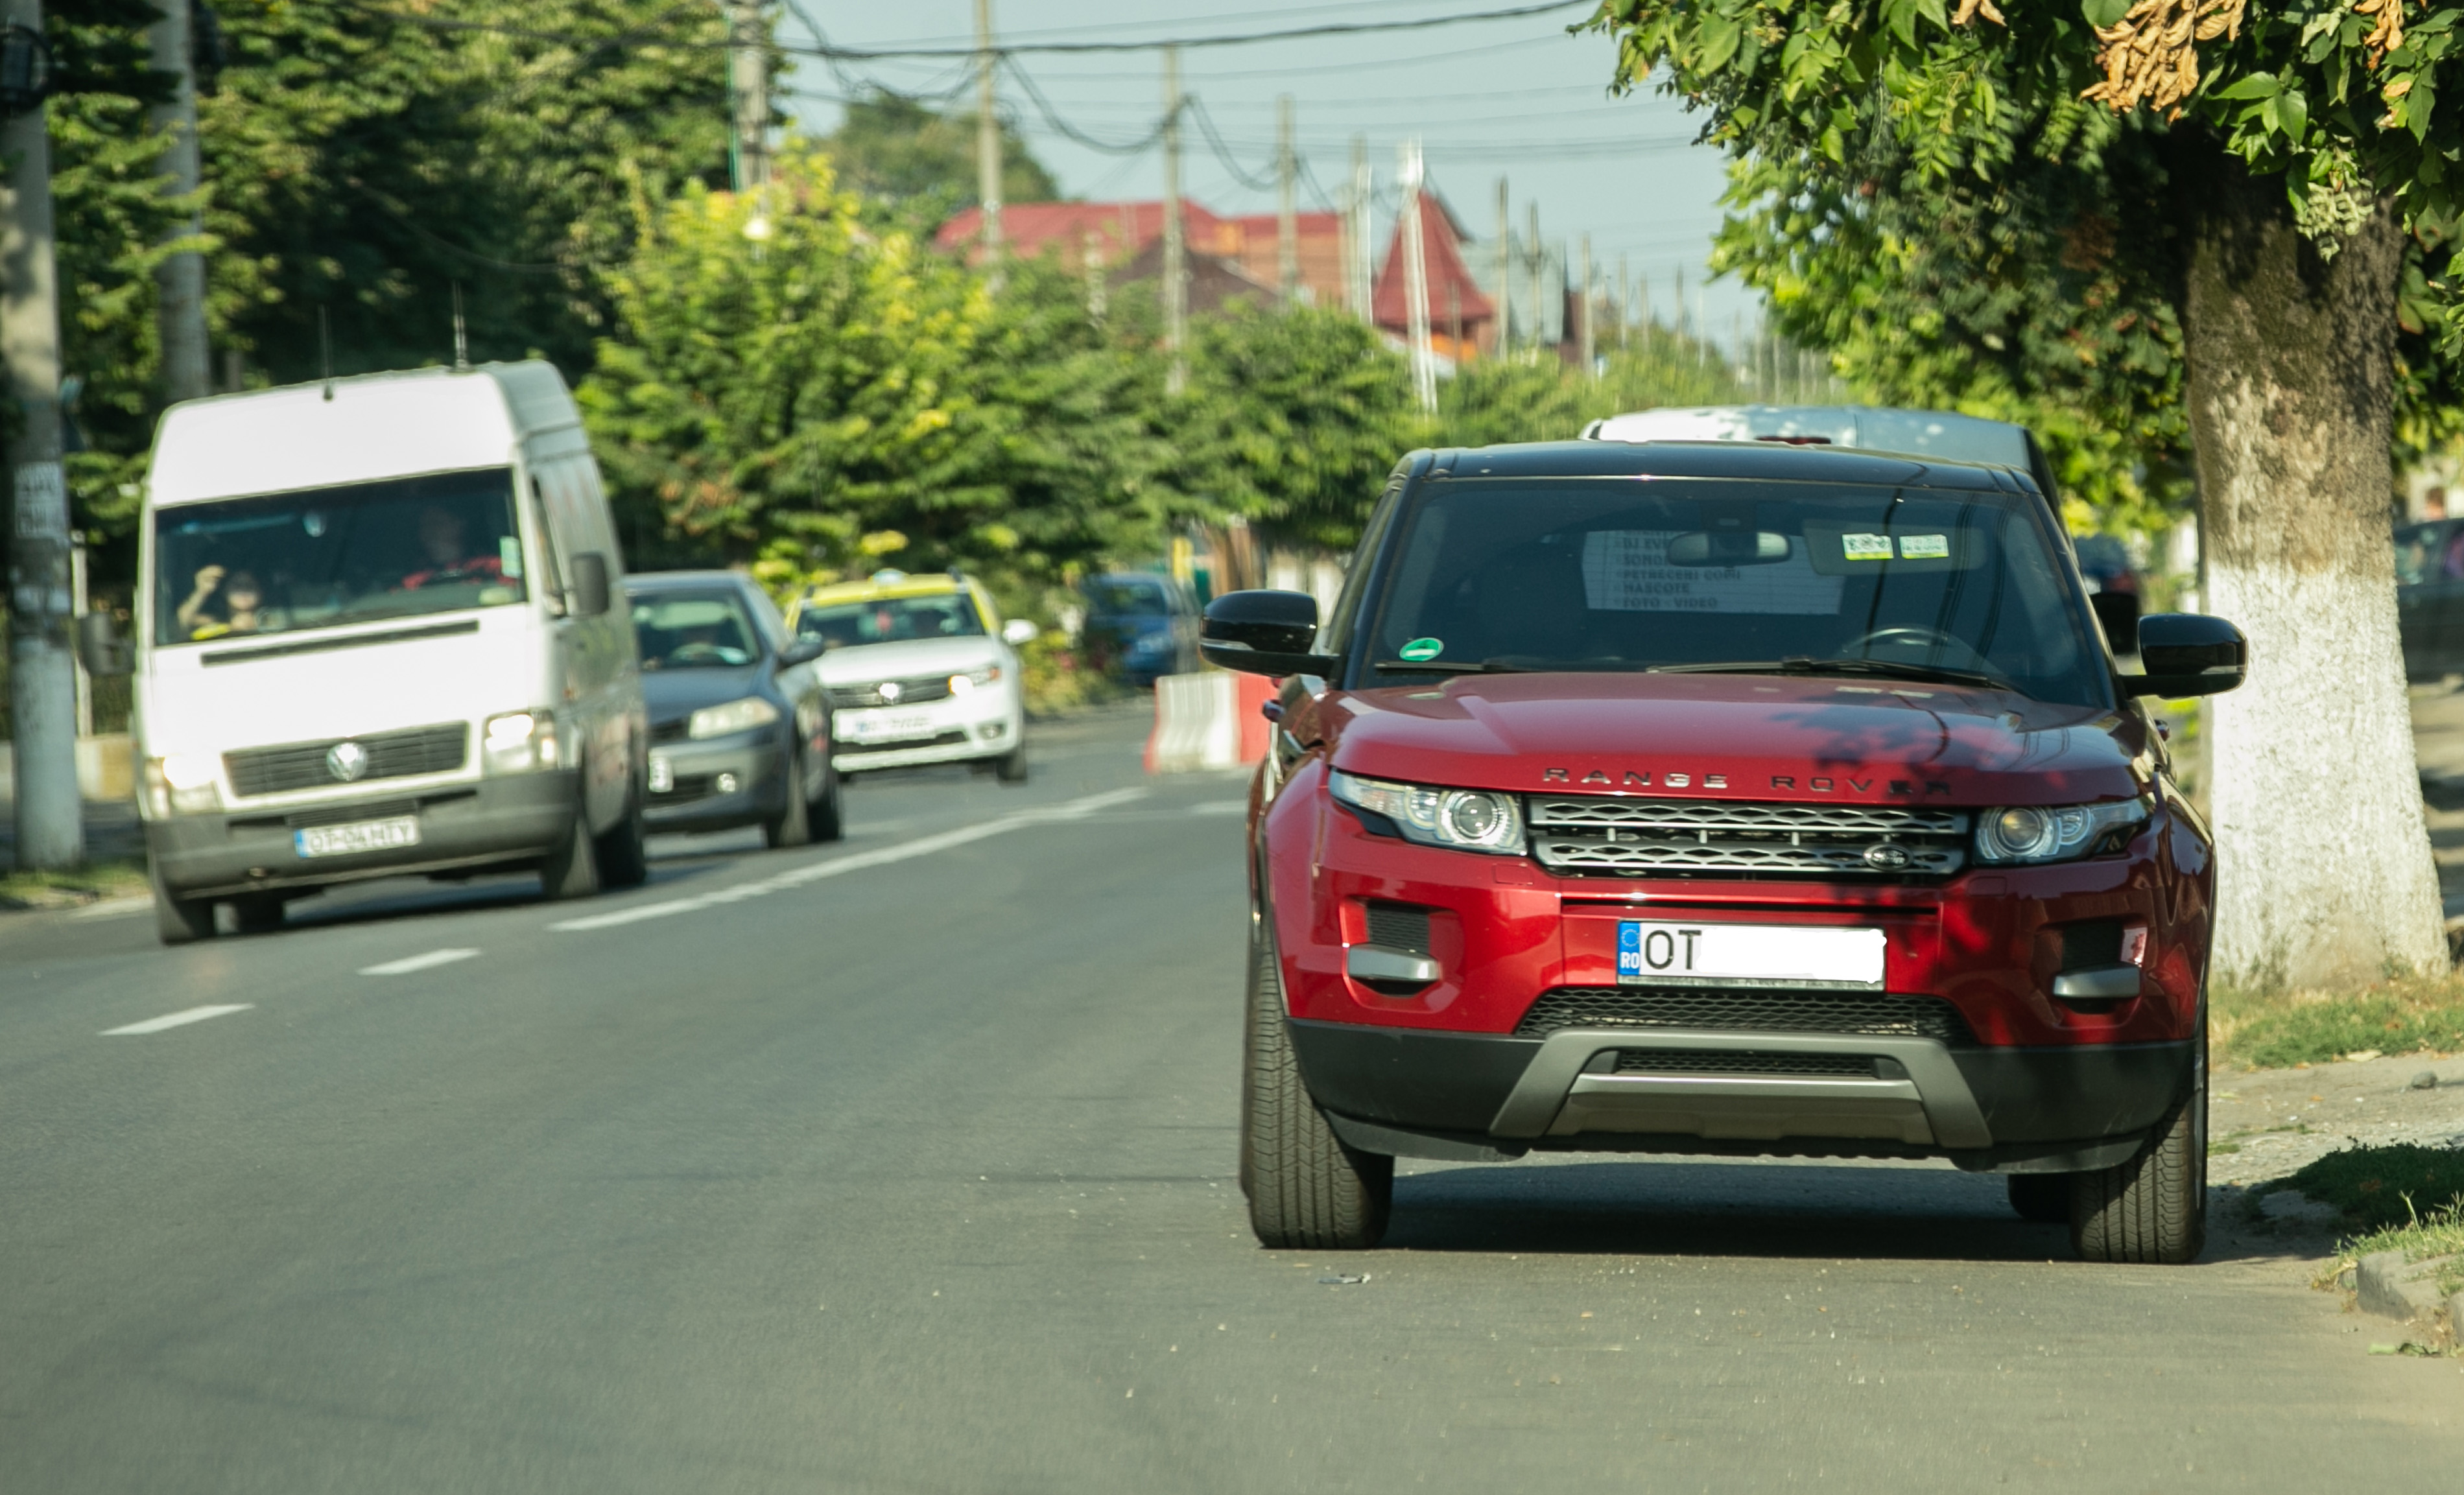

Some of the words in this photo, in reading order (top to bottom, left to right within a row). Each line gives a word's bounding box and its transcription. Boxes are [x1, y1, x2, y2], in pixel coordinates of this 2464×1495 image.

[1543, 768, 1728, 788] RANGE
[1770, 775, 1951, 795] ROVER
[1620, 951, 1640, 969] RO
[1645, 929, 1702, 971] OT
